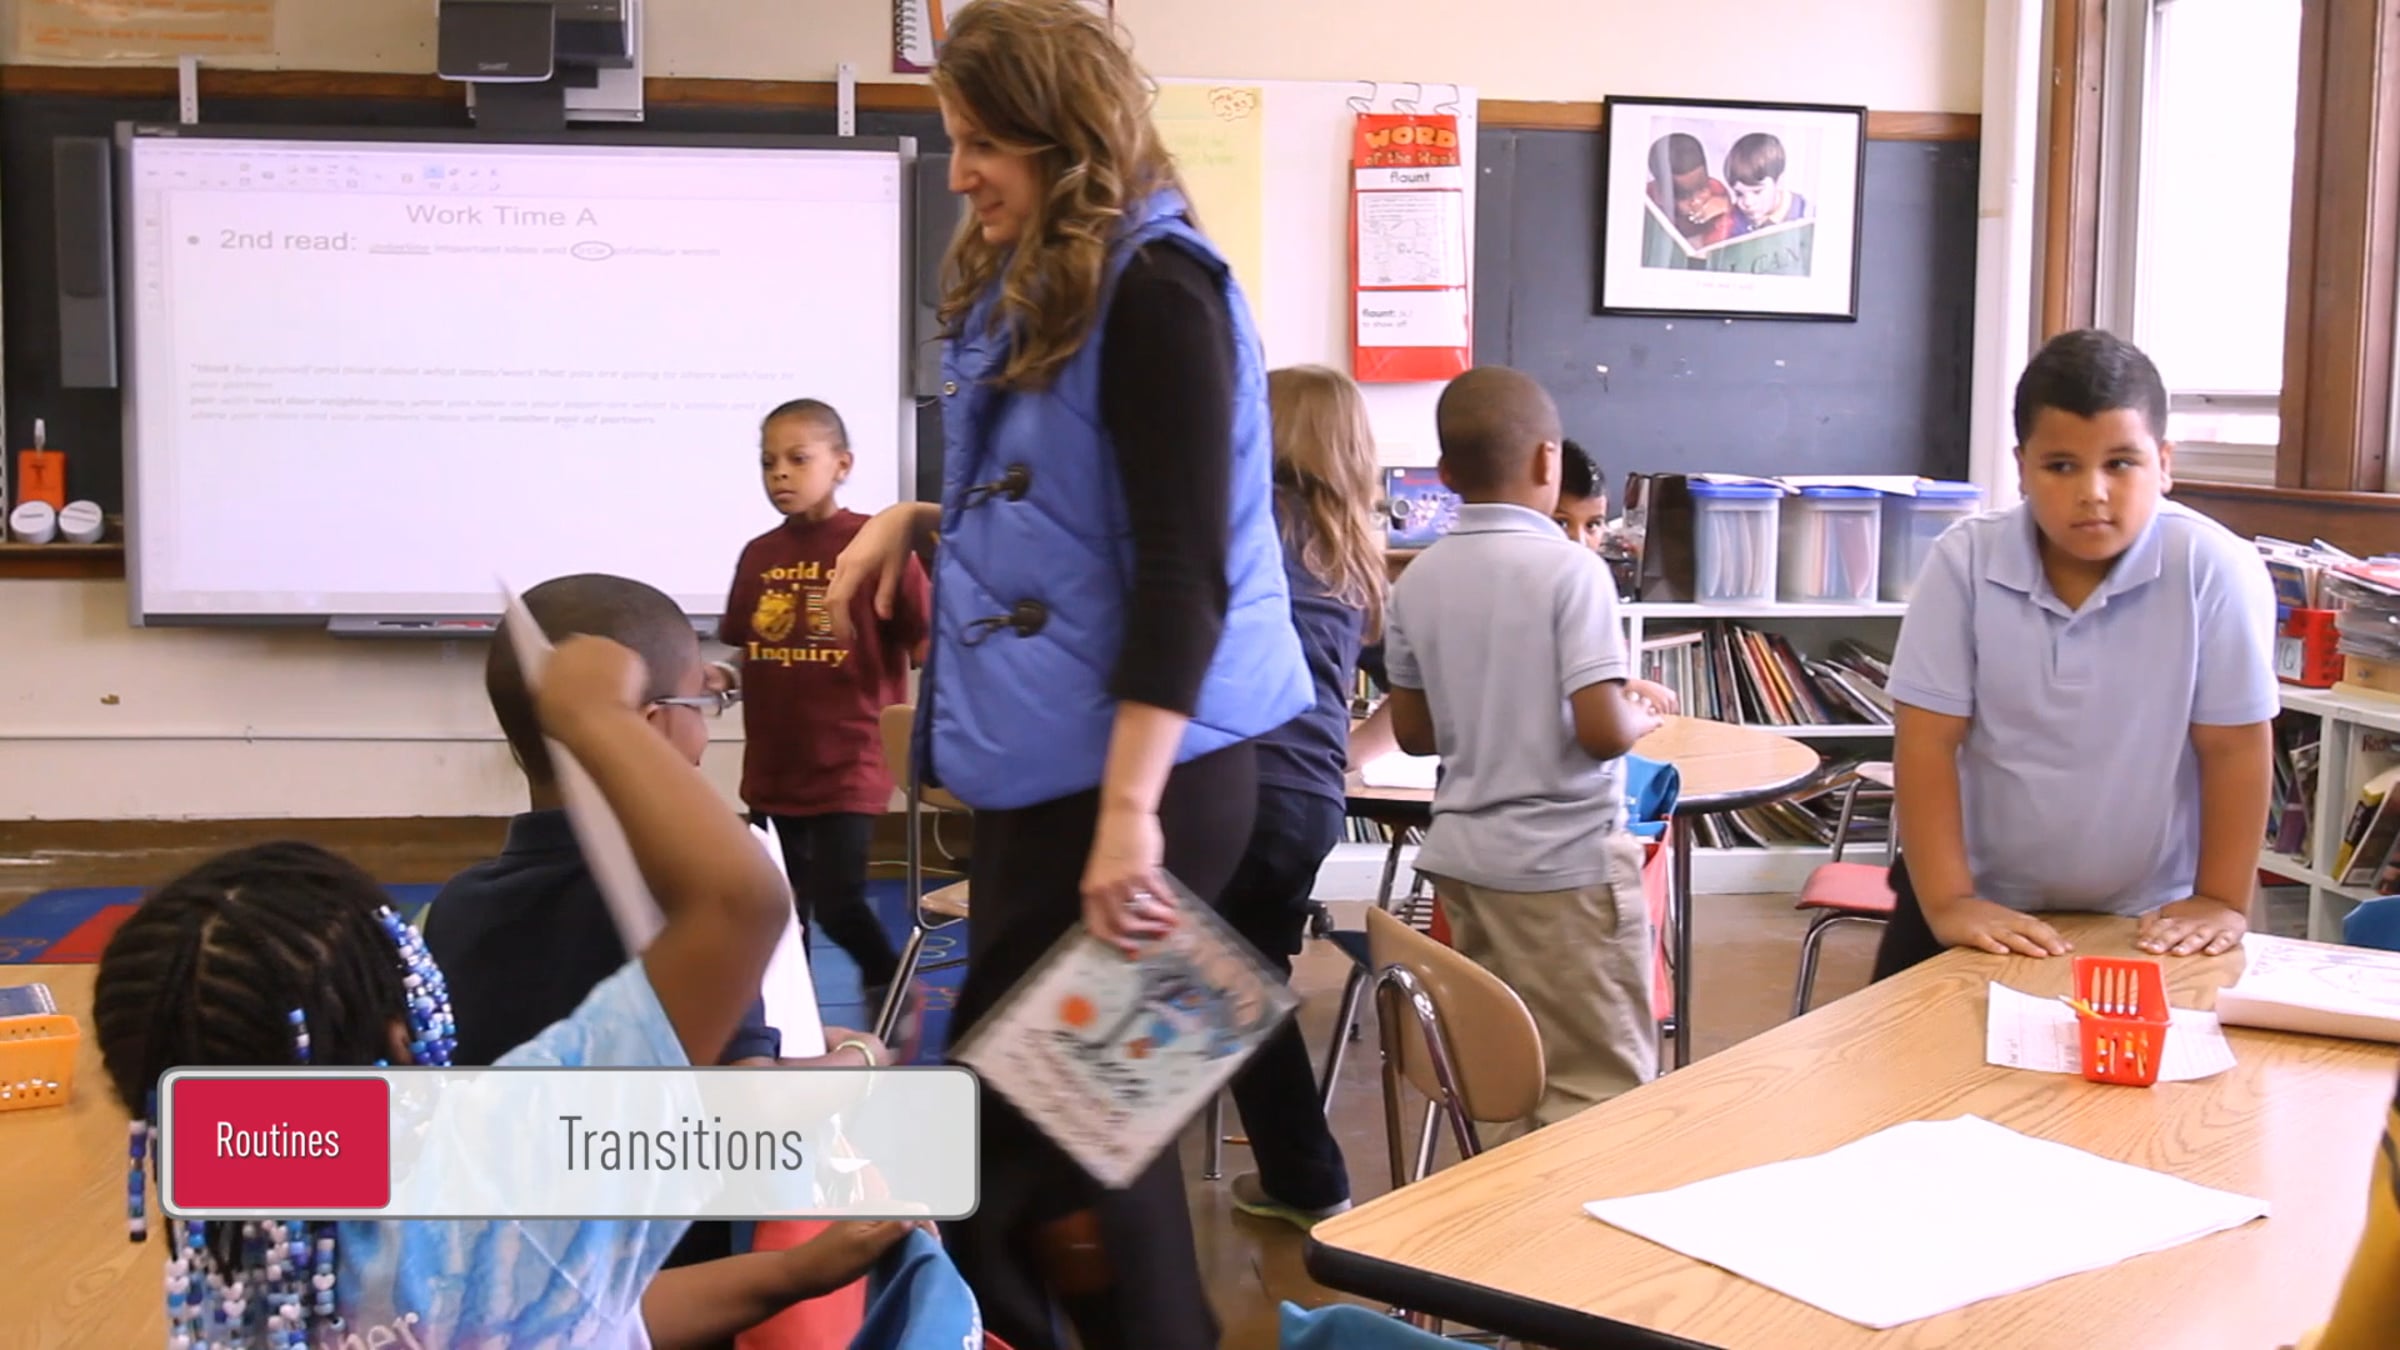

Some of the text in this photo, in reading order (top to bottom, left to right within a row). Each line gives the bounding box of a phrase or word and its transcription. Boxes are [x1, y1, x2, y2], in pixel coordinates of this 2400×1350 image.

[1364, 126, 1457, 149] WORD
[1364, 151, 1457, 166] of the Week
[1389, 171, 1431, 183] flaunt
[406, 205, 598, 227] Work Time A
[220, 229, 273, 250] 2nd
[283, 231, 357, 251] read:
[748, 642, 850, 667] Inquiry
